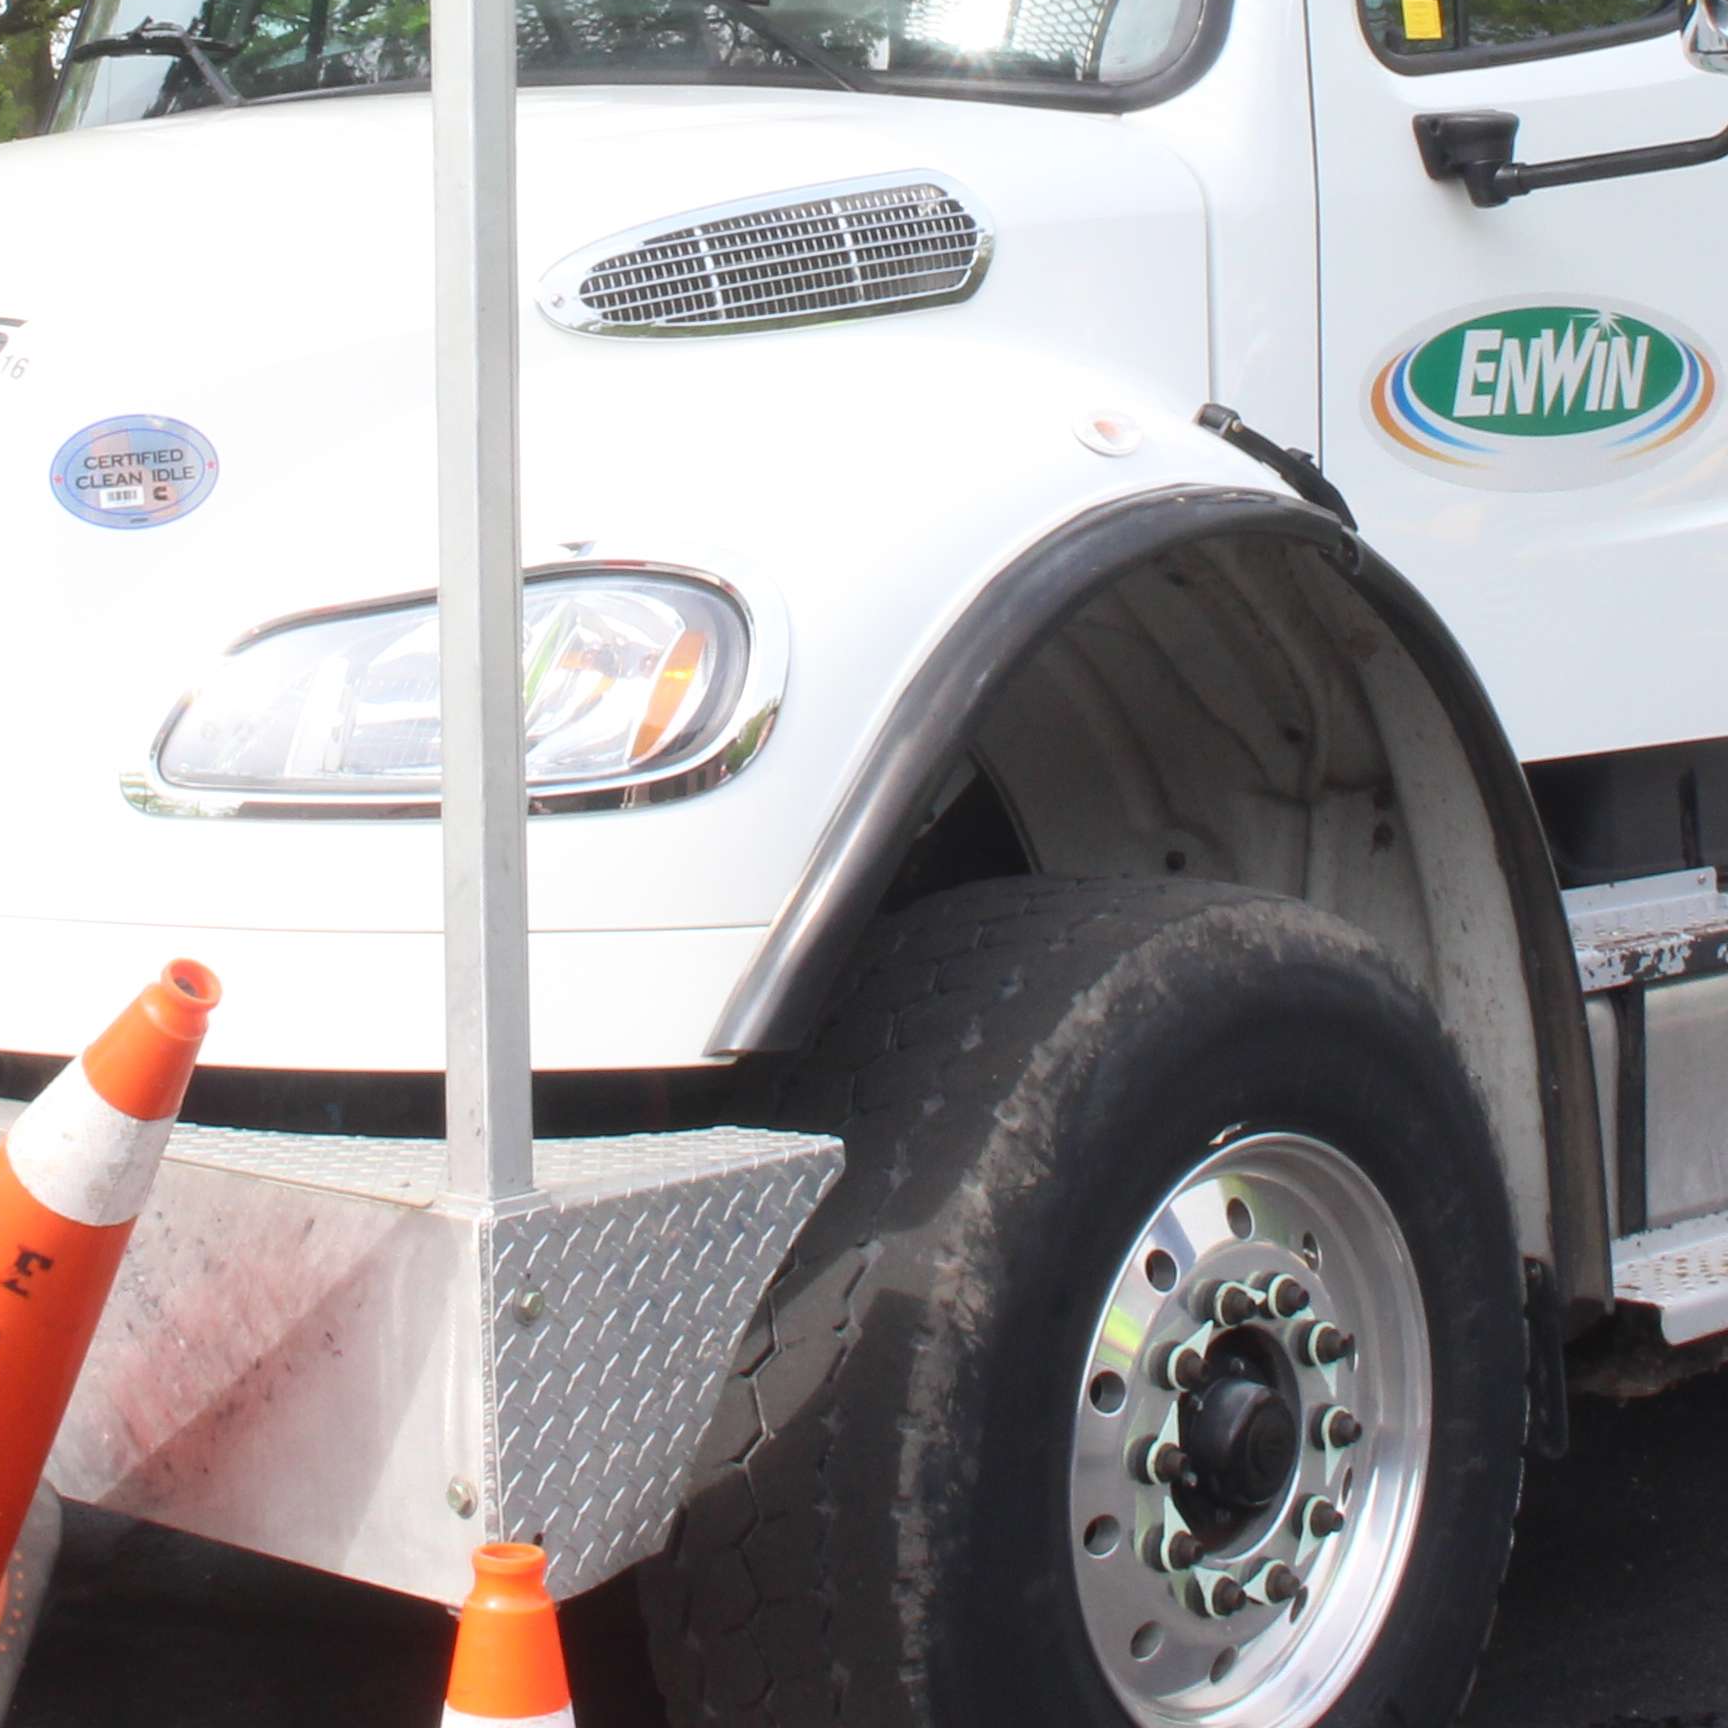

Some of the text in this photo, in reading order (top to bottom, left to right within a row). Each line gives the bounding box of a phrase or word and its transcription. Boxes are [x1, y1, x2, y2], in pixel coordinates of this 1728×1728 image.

[1, 355, 29, 380] 16
[84, 449, 183, 470] CERTIFIED
[75, 466, 195, 490] CLEAN IDLE
